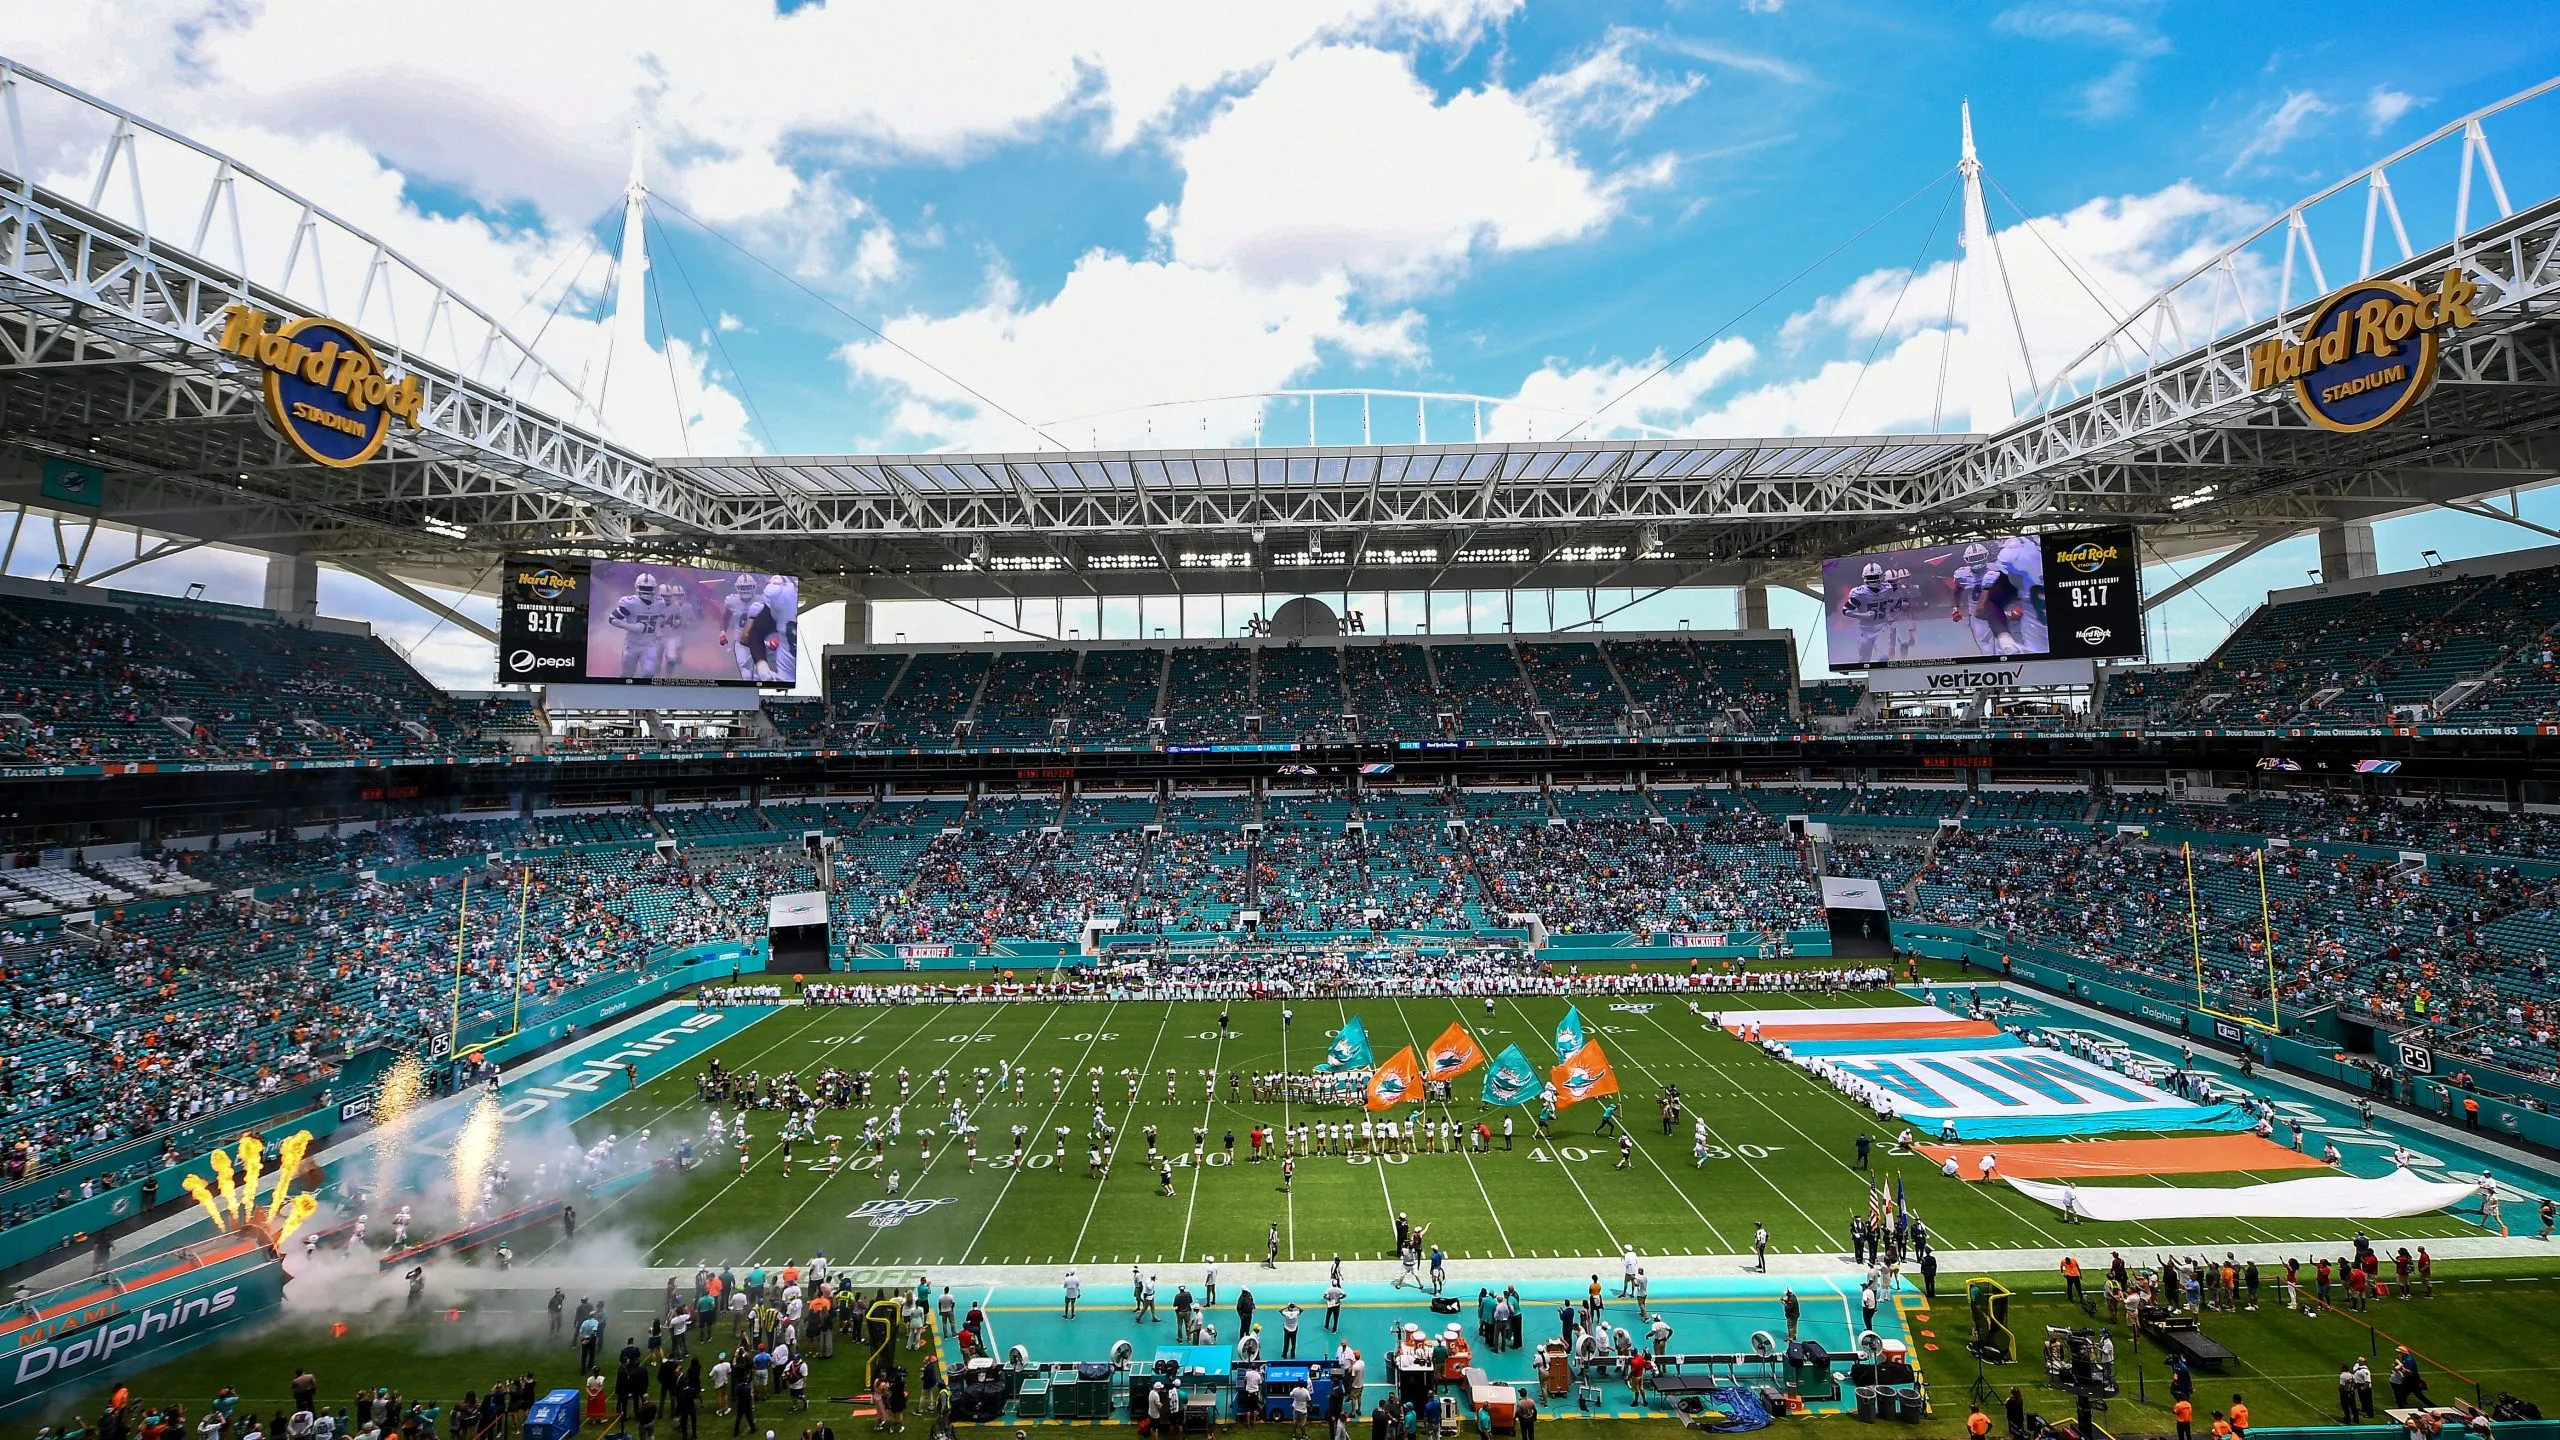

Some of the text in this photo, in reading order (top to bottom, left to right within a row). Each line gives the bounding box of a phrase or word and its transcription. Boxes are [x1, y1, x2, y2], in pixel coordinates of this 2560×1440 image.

[2250, 268, 2480, 390] Hard Rock
[219, 304, 424, 430] Hard Rock
[2322, 365, 2406, 404] STADIUM
[292, 402, 366, 438] STADIUM
[2057, 546, 2117, 563] Hard Rock
[518, 573, 576, 589] Hard Rock
[2428, 570, 2442, 578] 329
[2058, 579, 2089, 588] COUNTDOWN
[2071, 586, 2108, 608] 9:17
[528, 612, 563, 633] 9:17
[2076, 629, 2112, 638] Hard Rock
[536, 657, 575, 669] pepsi
[1927, 669, 2014, 689] verizon
[2504, 727, 2518, 735] 83
[3, 766, 64, 777] TAYLOR 99
[181, 762, 253, 772] ZACH THOMAS 54
[1686, 936, 1721, 947] KICKOFF
[912, 947, 946, 958] KICKOFF
[600, 1001, 627, 1016] Dolphins
[2142, 1005, 2181, 1024] Dolphins
[823, 1035, 869, 1046] 10
[947, 1033, 997, 1044] 20
[1073, 1032, 1120, 1042] 30
[2226, 1029, 2238, 1038] NFL
[433, 1036, 449, 1054] 25
[2404, 1047, 2426, 1068] 25
[988, 1153, 1054, 1170] 30
[1164, 1151, 1229, 1168] 40
[1346, 1149, 1409, 1165] 50
[1526, 1146, 1590, 1163] 40
[807, 1155, 877, 1172] 20
[873, 1217, 901, 1226] NFL
[18, 1302, 119, 1347] MIAMI
[14, 1286, 239, 1385] Dolphins
